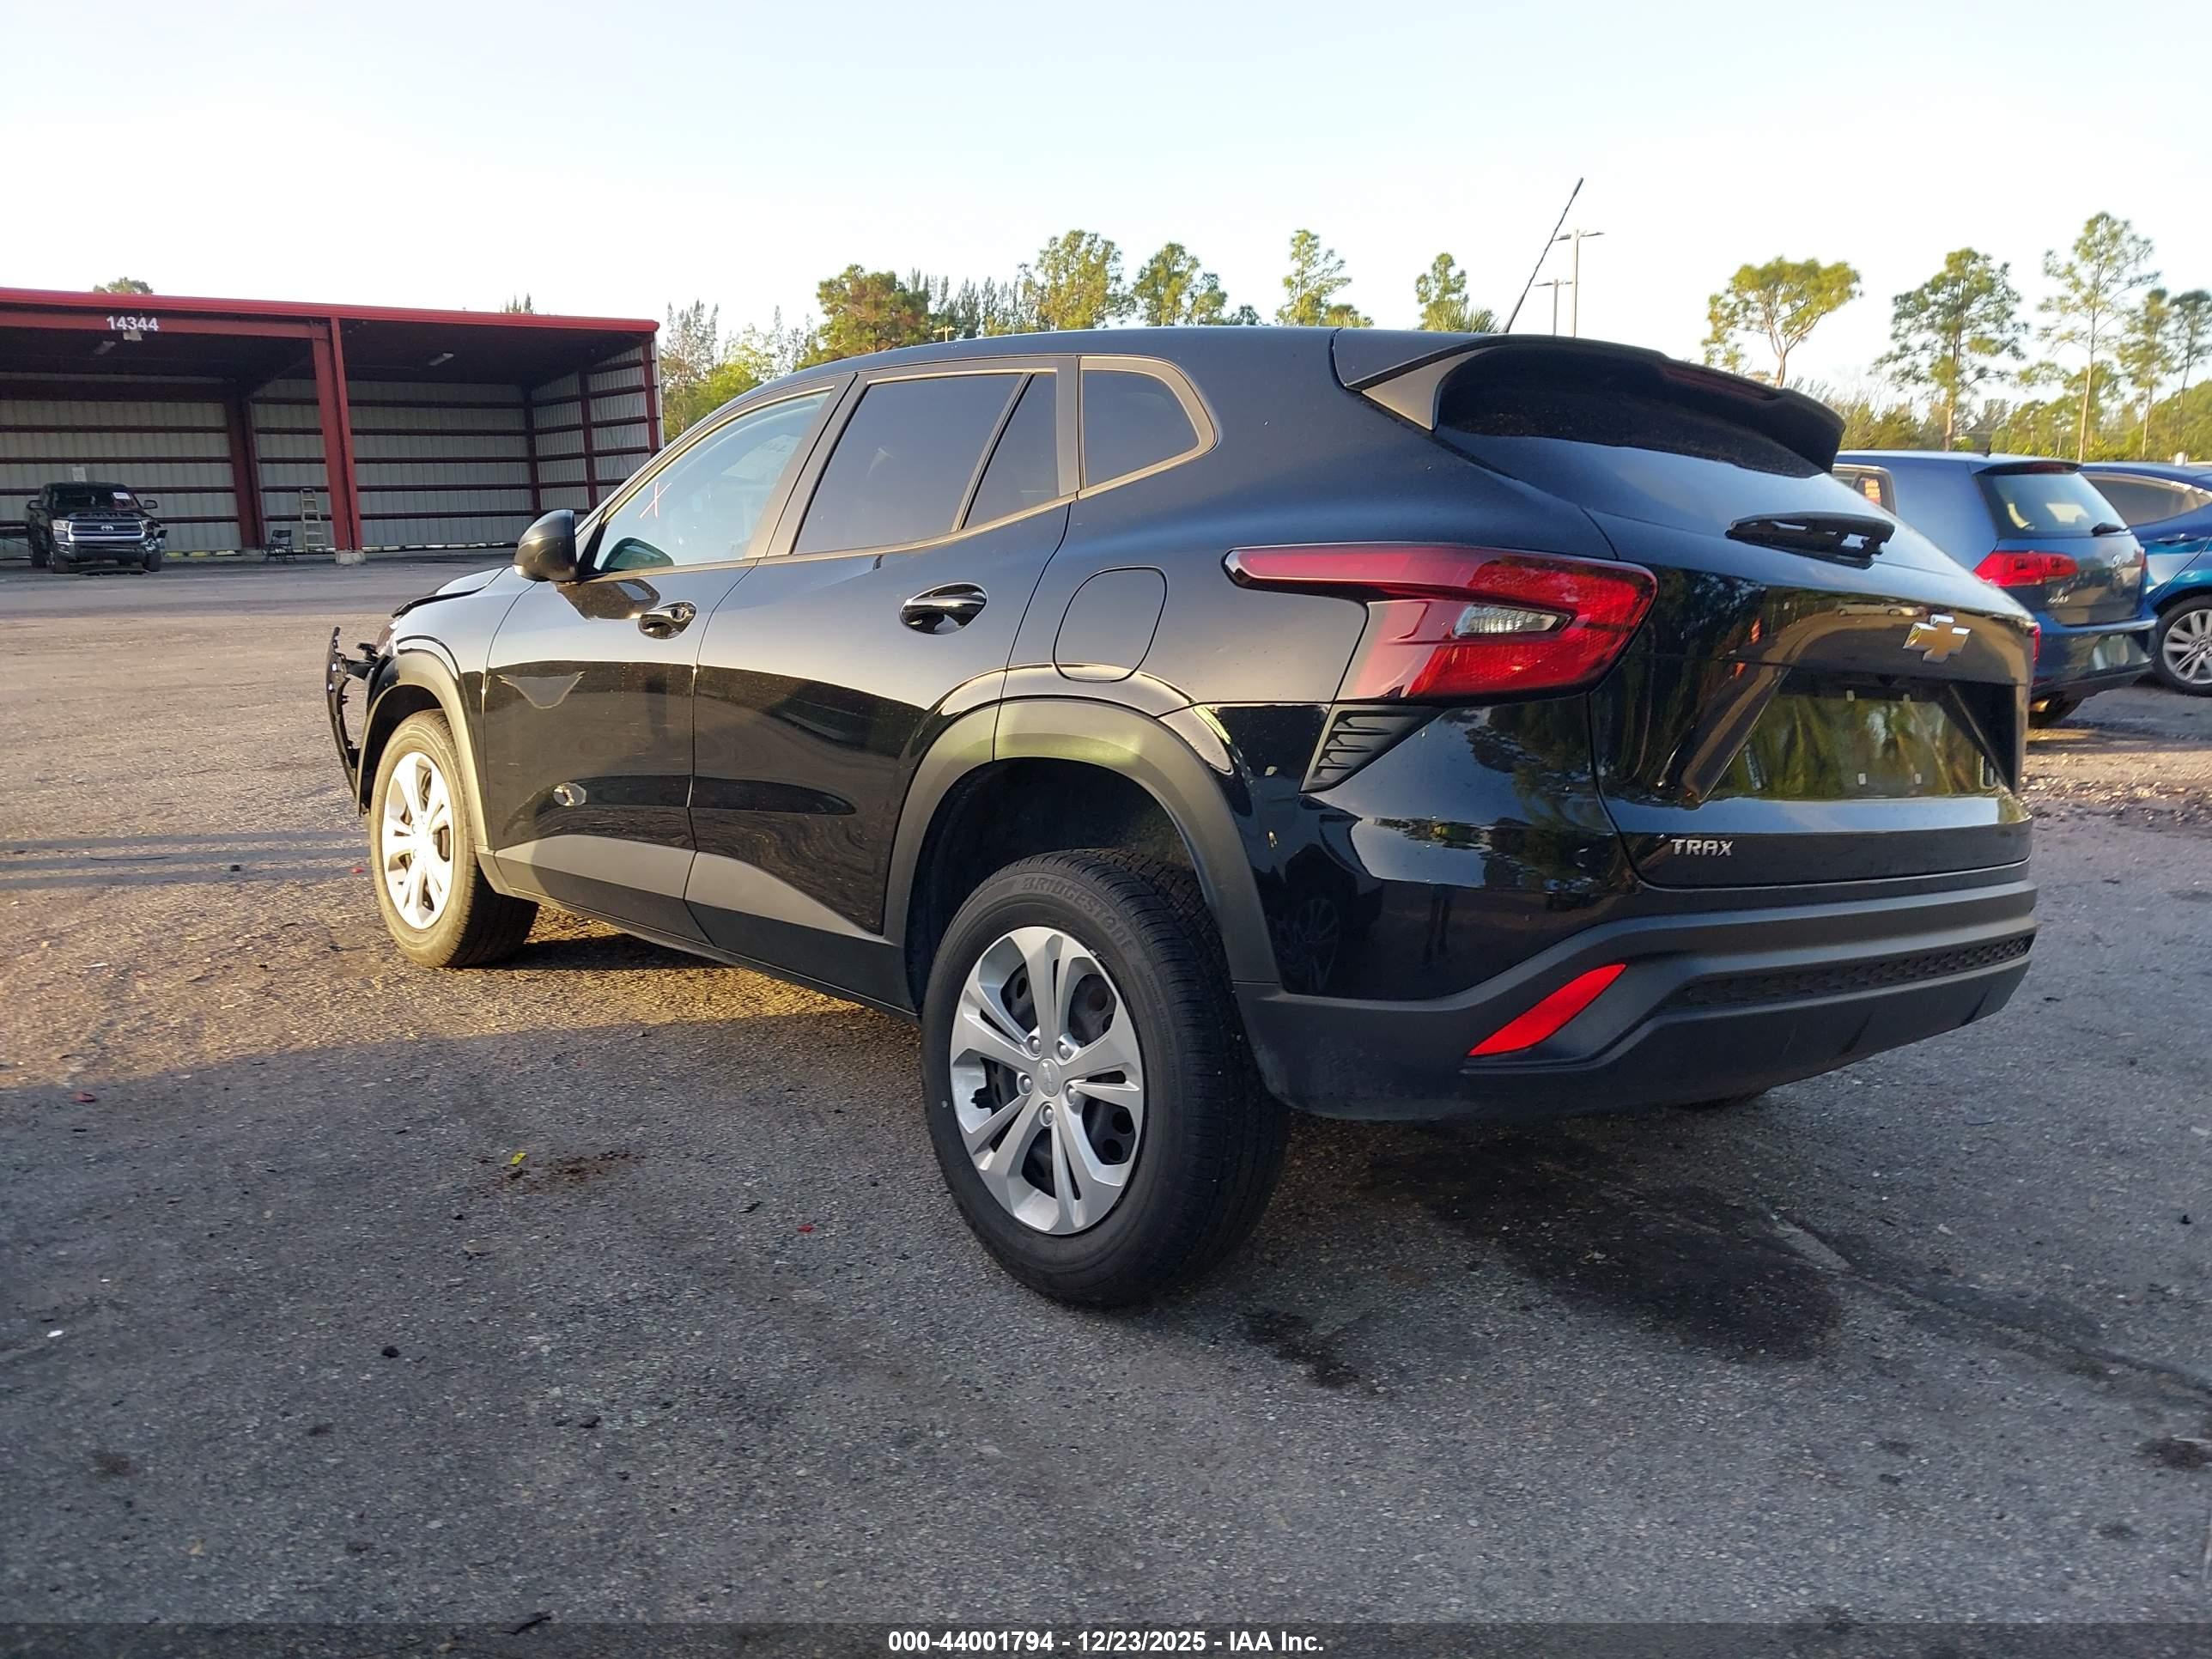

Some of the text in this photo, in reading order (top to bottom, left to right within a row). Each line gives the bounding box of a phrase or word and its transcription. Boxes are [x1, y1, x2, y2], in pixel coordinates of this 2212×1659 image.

[106, 315, 160, 331] 14344
[1670, 838, 1734, 856] TRAX
[1022, 876, 1135, 954] BRIDGESTONE
